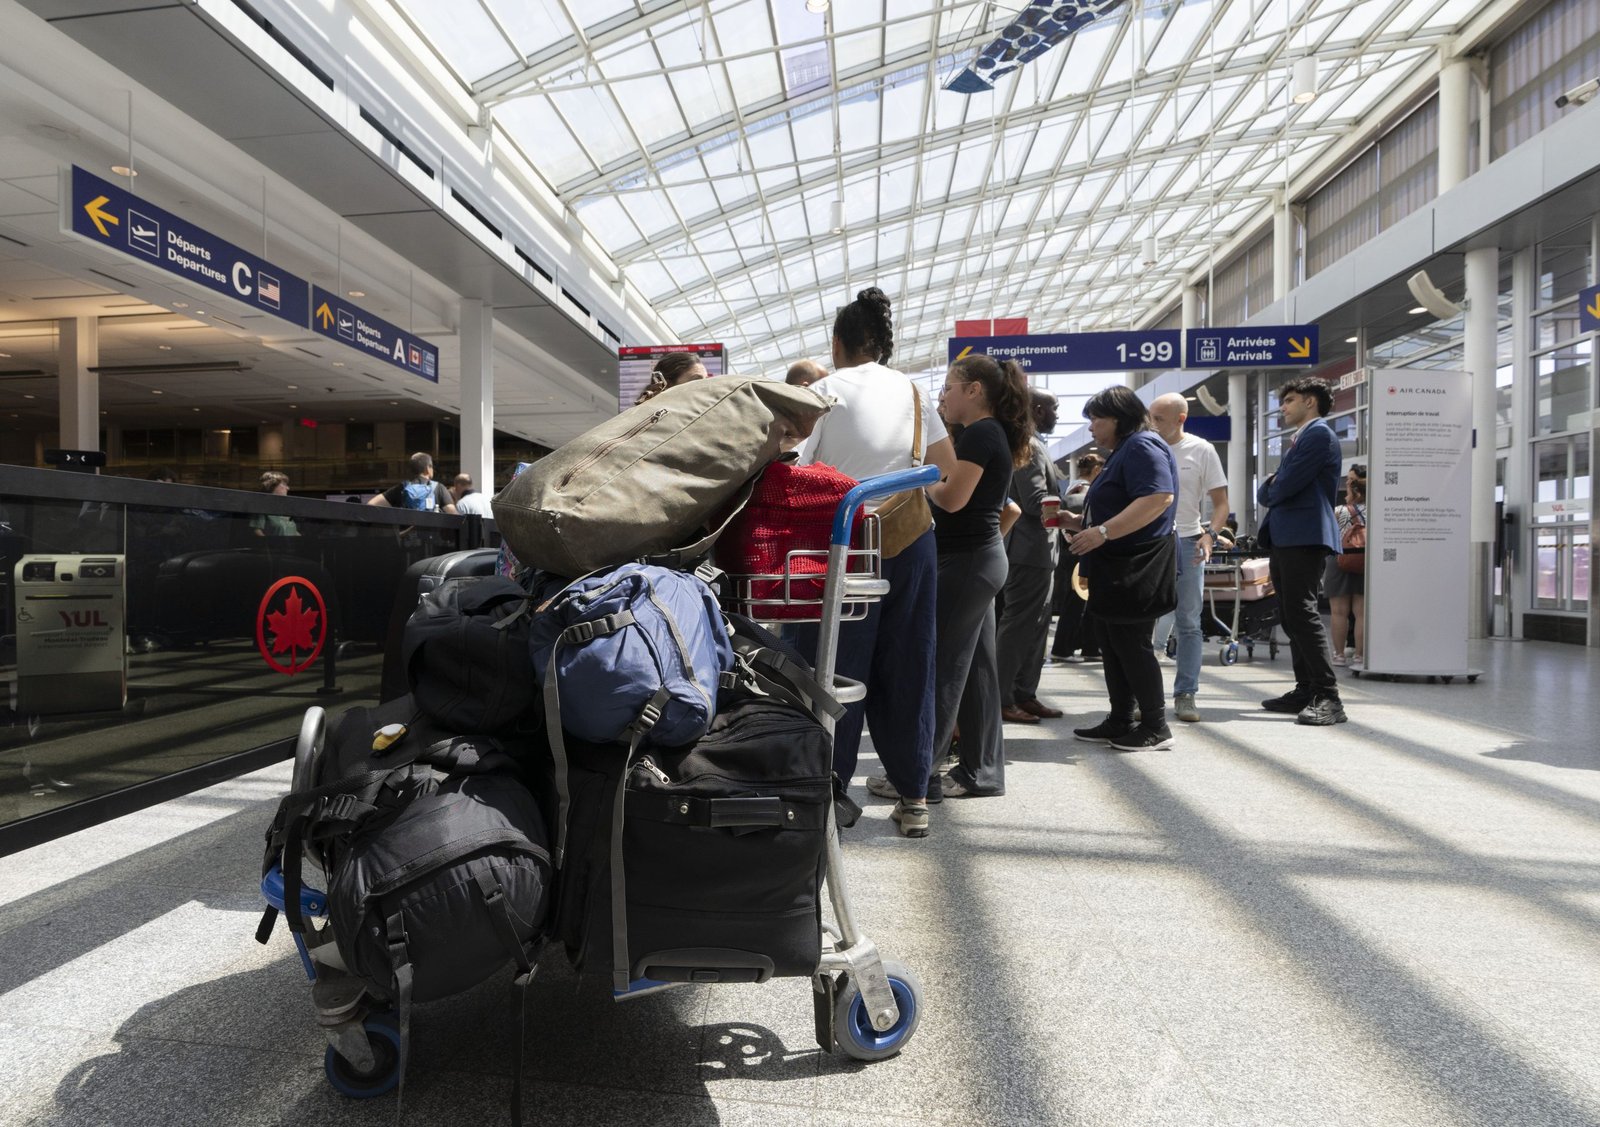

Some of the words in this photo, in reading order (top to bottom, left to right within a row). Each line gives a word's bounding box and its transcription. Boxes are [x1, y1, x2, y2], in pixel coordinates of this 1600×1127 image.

[167, 230, 212, 261] Départs
[167, 248, 227, 284] Departures
[231, 261, 252, 296] C
[356, 320, 381, 339] Départs
[356, 333, 390, 355] Departures
[393, 338, 406, 364] A
[986, 345, 1068, 357] Enregistrement
[1116, 341, 1173, 363] 1-99
[1227, 336, 1276, 347] Arrivées
[1227, 350, 1273, 361] Arrivals
[59, 610, 108, 627] YUL
